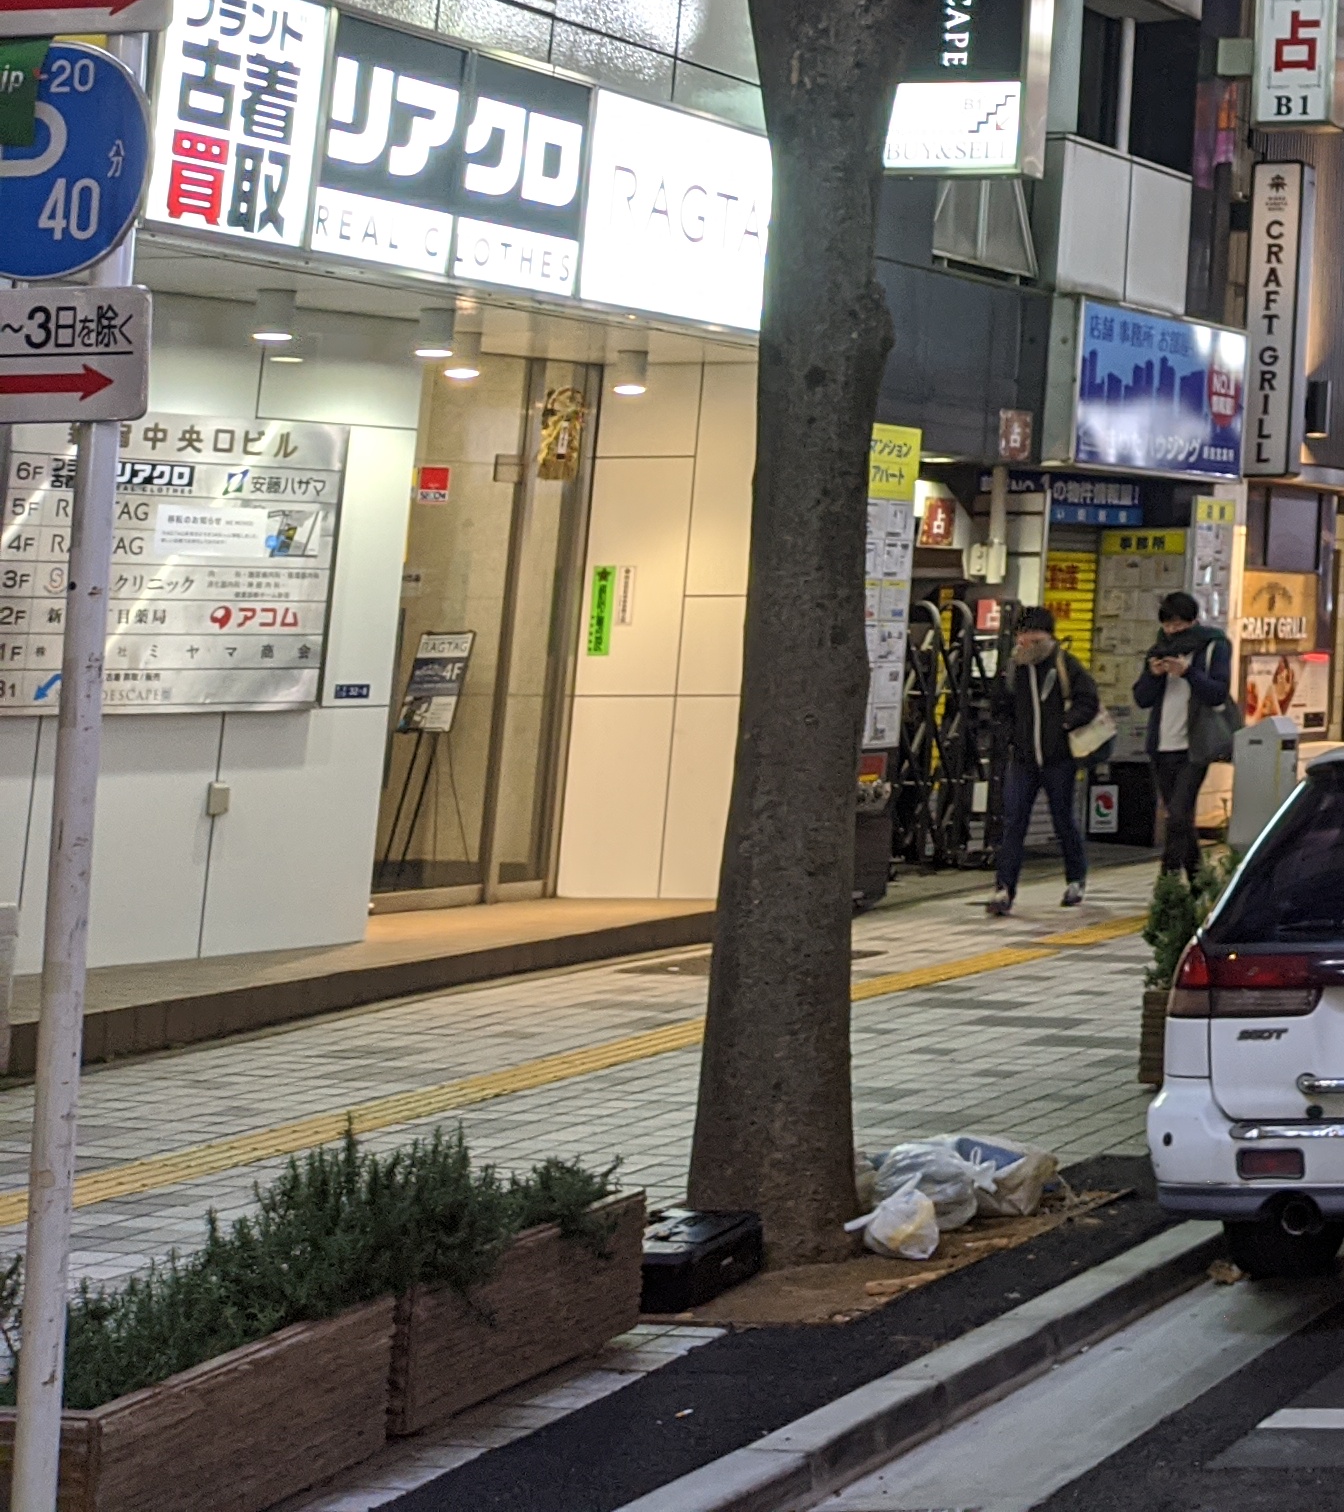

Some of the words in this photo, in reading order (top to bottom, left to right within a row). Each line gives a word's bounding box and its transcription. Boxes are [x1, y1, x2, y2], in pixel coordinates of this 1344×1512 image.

[1273, 10, 1319, 72] 占
[178, 38, 301, 146] 古着
[1275, 94, 1311, 117] B1
[327, 55, 585, 209] リアクロ
[107, 139, 126, 179] 分
[168, 129, 292, 238] 買取
[38, 178, 100, 240] 40
[315, 204, 399, 252] REAL
[424, 228, 573, 283] CLOTHES
[1261, 219, 1285, 337] CRAFT
[1255, 346, 1280, 464] GRILL
[16, 462, 44, 482] 6F
[250, 474, 327, 497] 安藤ハザマ
[11, 500, 40, 519] 5F
[931, 508, 947, 536] 占
[7, 535, 35, 554] 4F
[2, 570, 31, 590] 3F
[0, 608, 27, 626] 2F
[237, 606, 300, 630] アコム
[1240, 615, 1278, 639] CRAFT
[1278, 616, 1308, 640] GRILL
[420, 638, 470, 653] RAGTAG
[441, 661, 466, 682] 4F
